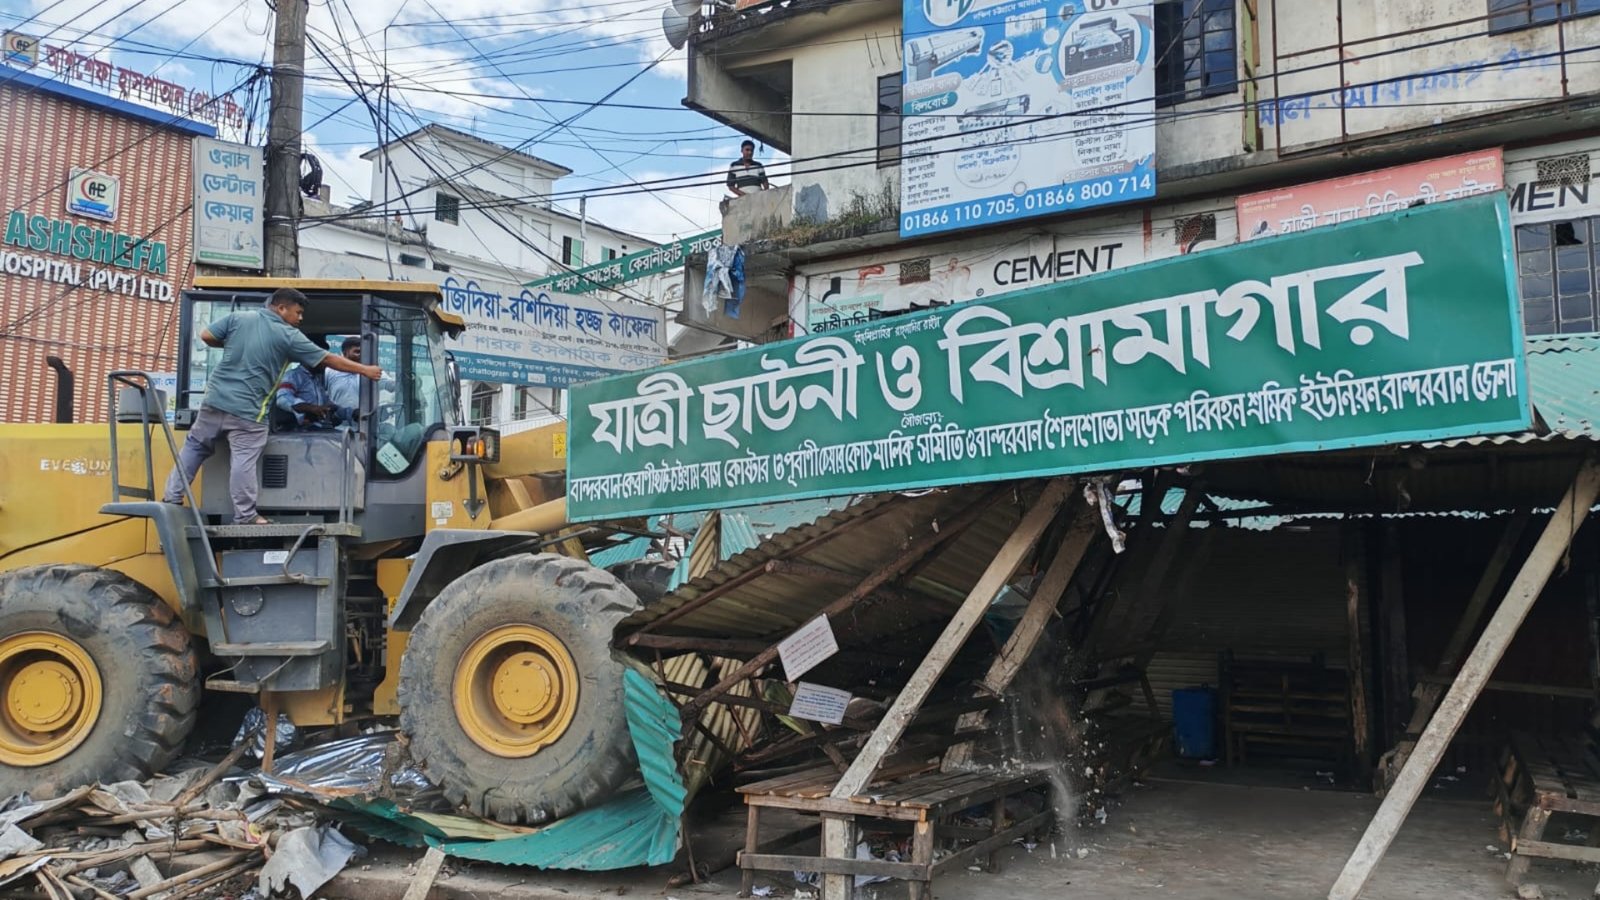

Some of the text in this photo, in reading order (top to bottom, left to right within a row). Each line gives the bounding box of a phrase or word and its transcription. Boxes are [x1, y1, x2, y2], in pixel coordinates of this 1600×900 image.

[208, 149, 250, 170] ওরাল
[203, 171, 256, 197] ডেন্টাল
[904, 174, 1152, 231] 01866 110 705, 01866 800 714
[204, 199, 255, 224] কেয়ার
[4, 210, 168, 275] ASHSHEFA
[628, 243, 683, 275] কেরানীহাট
[89, 267, 137, 296] (PVT)
[140, 279, 175, 303] LTD.
[993, 243, 1123, 287] CEMENT
[439, 277, 570, 330] জিদিয়া-রশিদিয়া
[606, 312, 659, 343] কাফেলা
[588, 250, 1425, 455] যাত্রী ছাউনী ও বিশ্রামাগার
[916, 422, 966, 465] সমিতি
[1126, 402, 1172, 446] সড়ক
[1173, 390, 1246, 434] পরিবহন
[1246, 380, 1298, 425] শ্রমিক
[1471, 358, 1518, 401] জেলা
